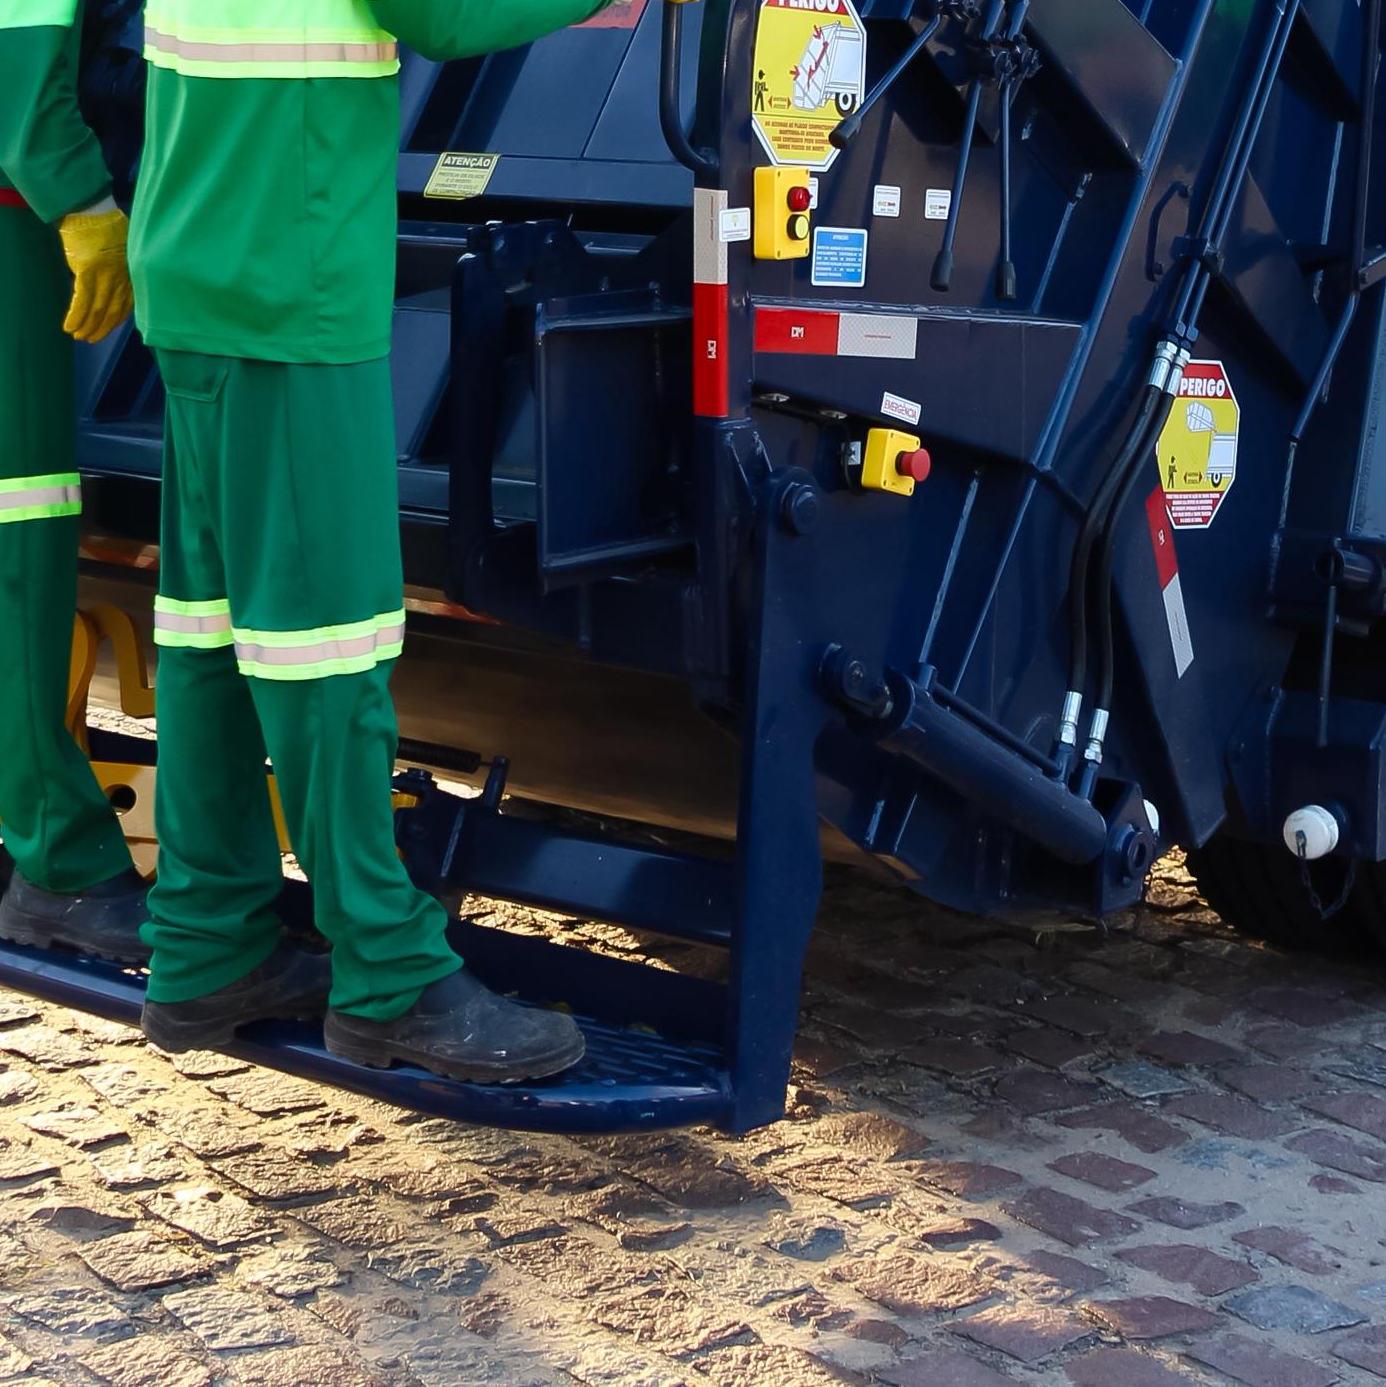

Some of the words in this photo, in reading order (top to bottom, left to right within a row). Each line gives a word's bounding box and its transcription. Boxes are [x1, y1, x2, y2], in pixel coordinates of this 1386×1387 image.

[444, 156, 491, 168] ATENÇÃO
[791, 326, 804, 338] DM
[707, 340, 717, 359] DM
[1179, 378, 1225, 397] PERIGO
[884, 399, 917, 420] EMERGÊNCIA
